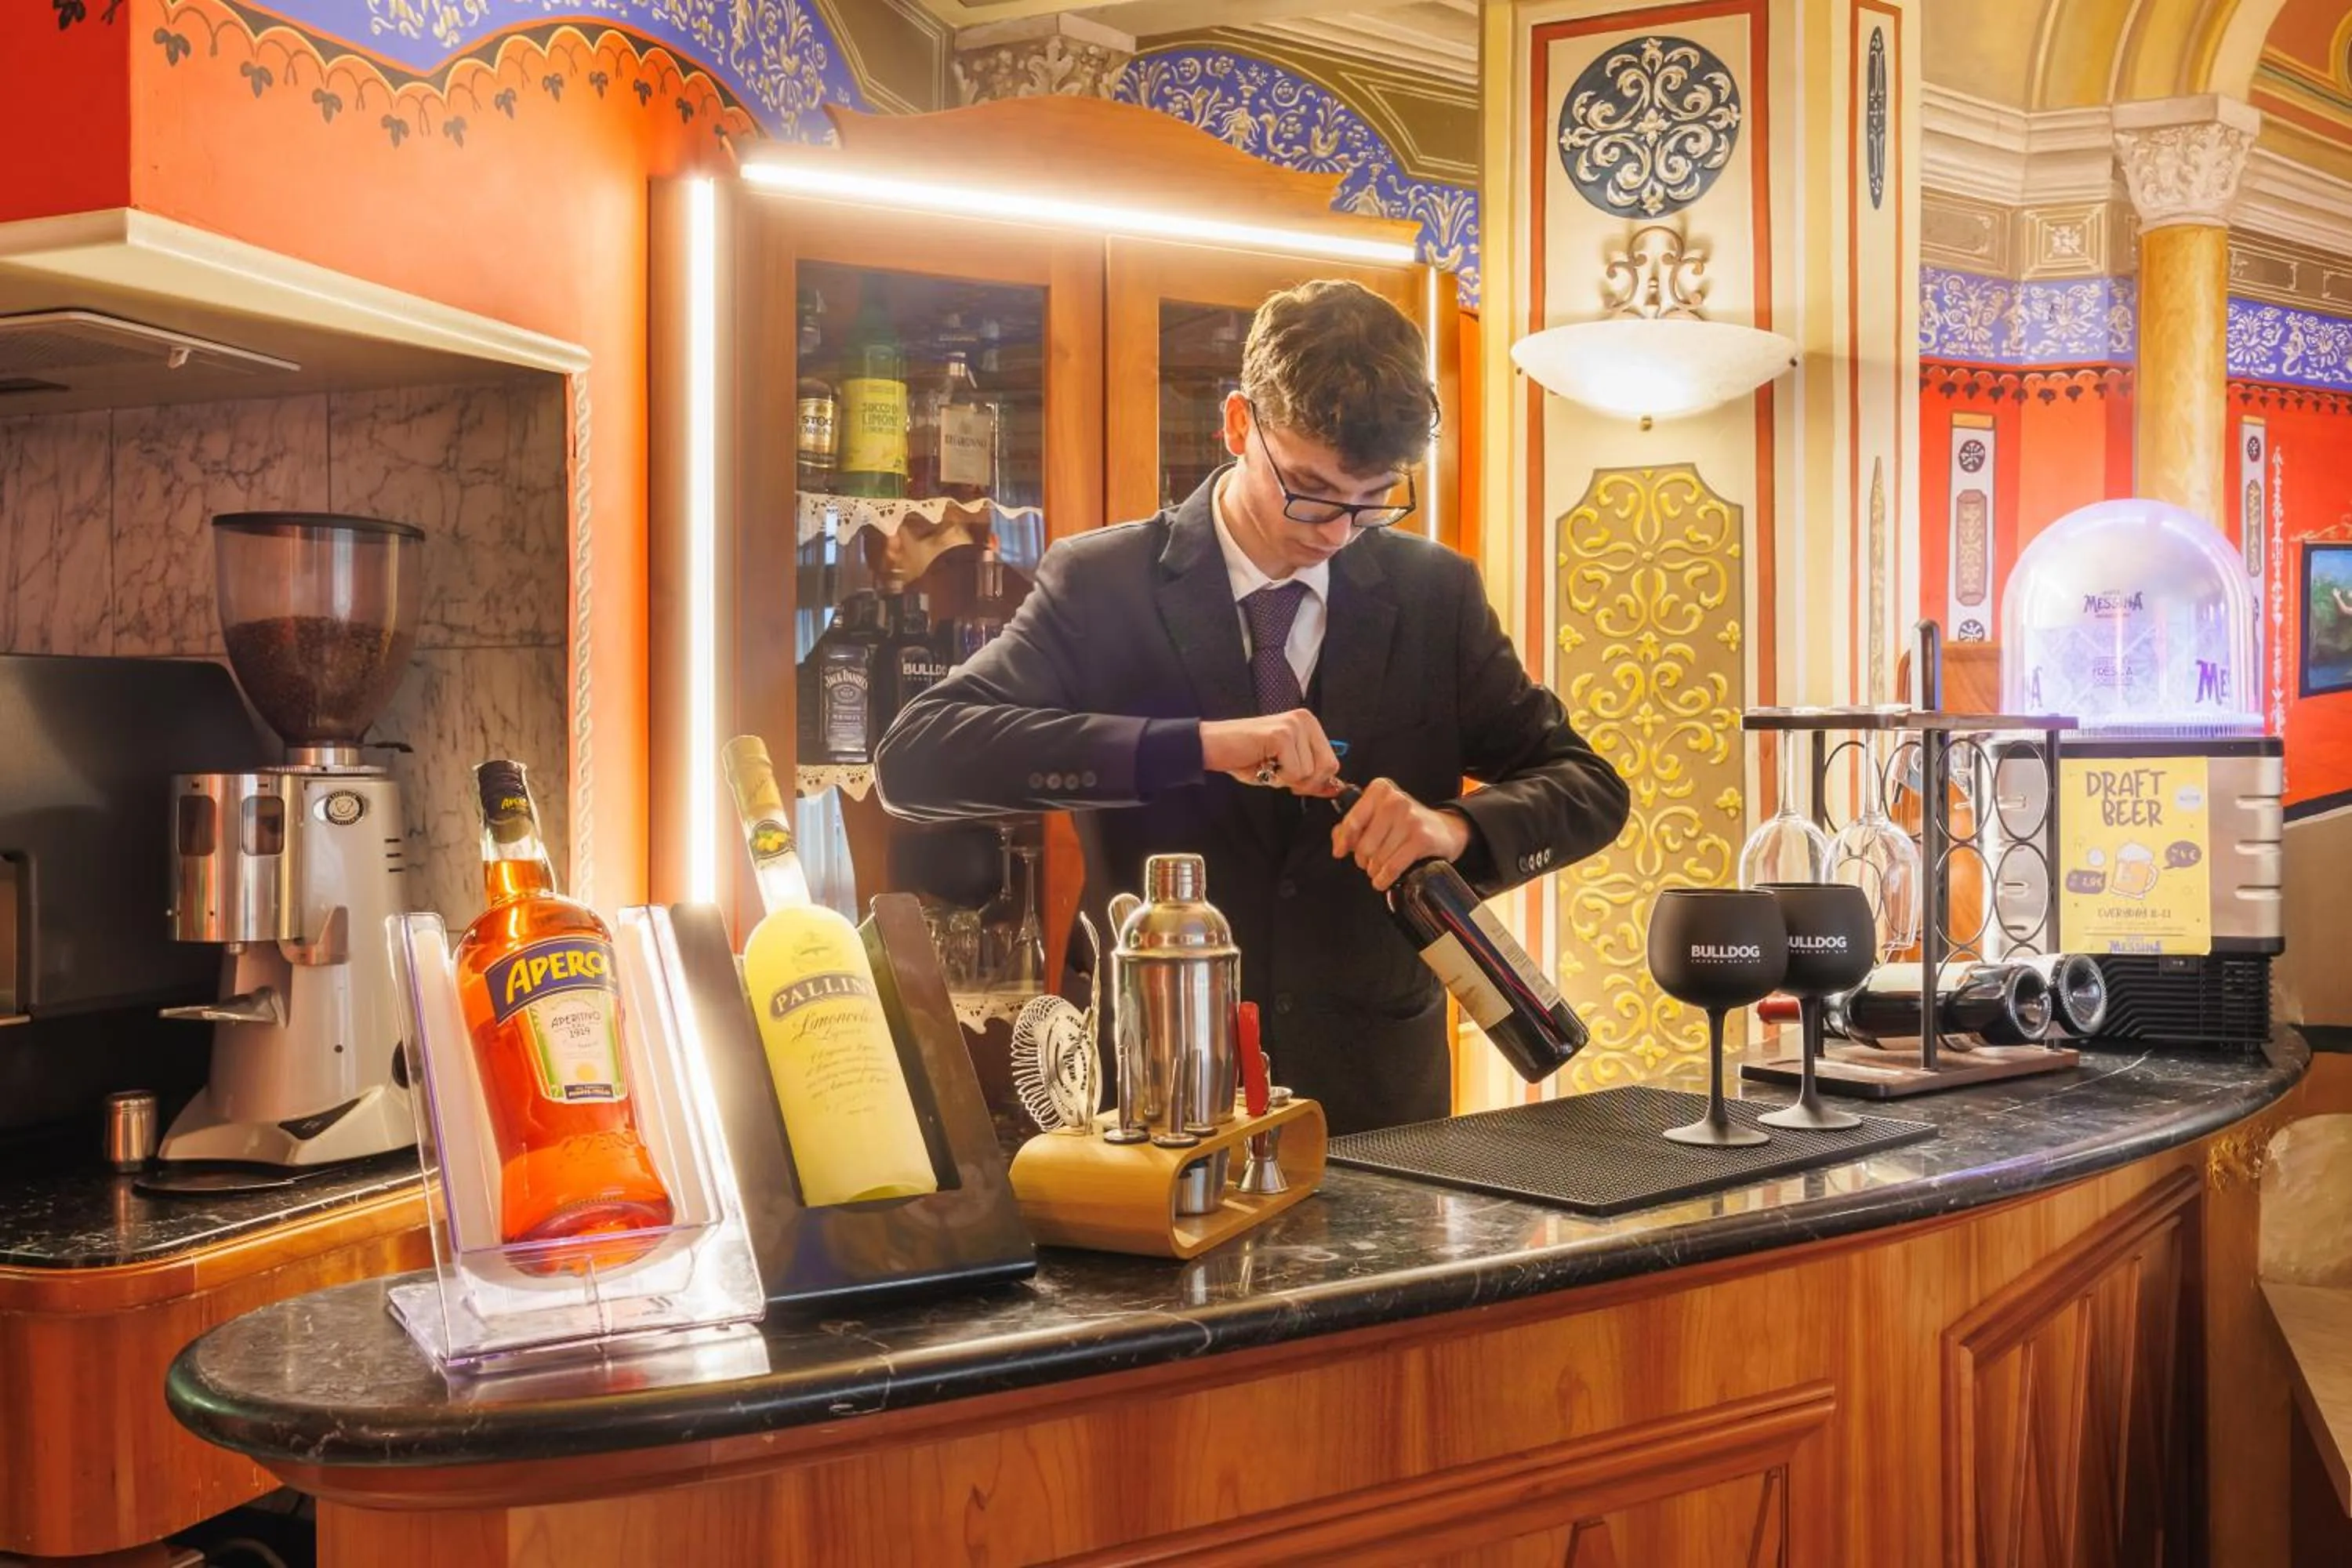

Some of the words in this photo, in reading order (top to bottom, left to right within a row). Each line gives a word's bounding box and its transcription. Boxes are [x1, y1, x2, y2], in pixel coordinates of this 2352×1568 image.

[902, 662, 948, 675] BULLDO
[2085, 768, 2167, 800] DRAFT
[2102, 798, 2163, 828] BEER
[1788, 935, 1847, 949] ULLDOG
[1691, 945, 1761, 958] BULLDOG
